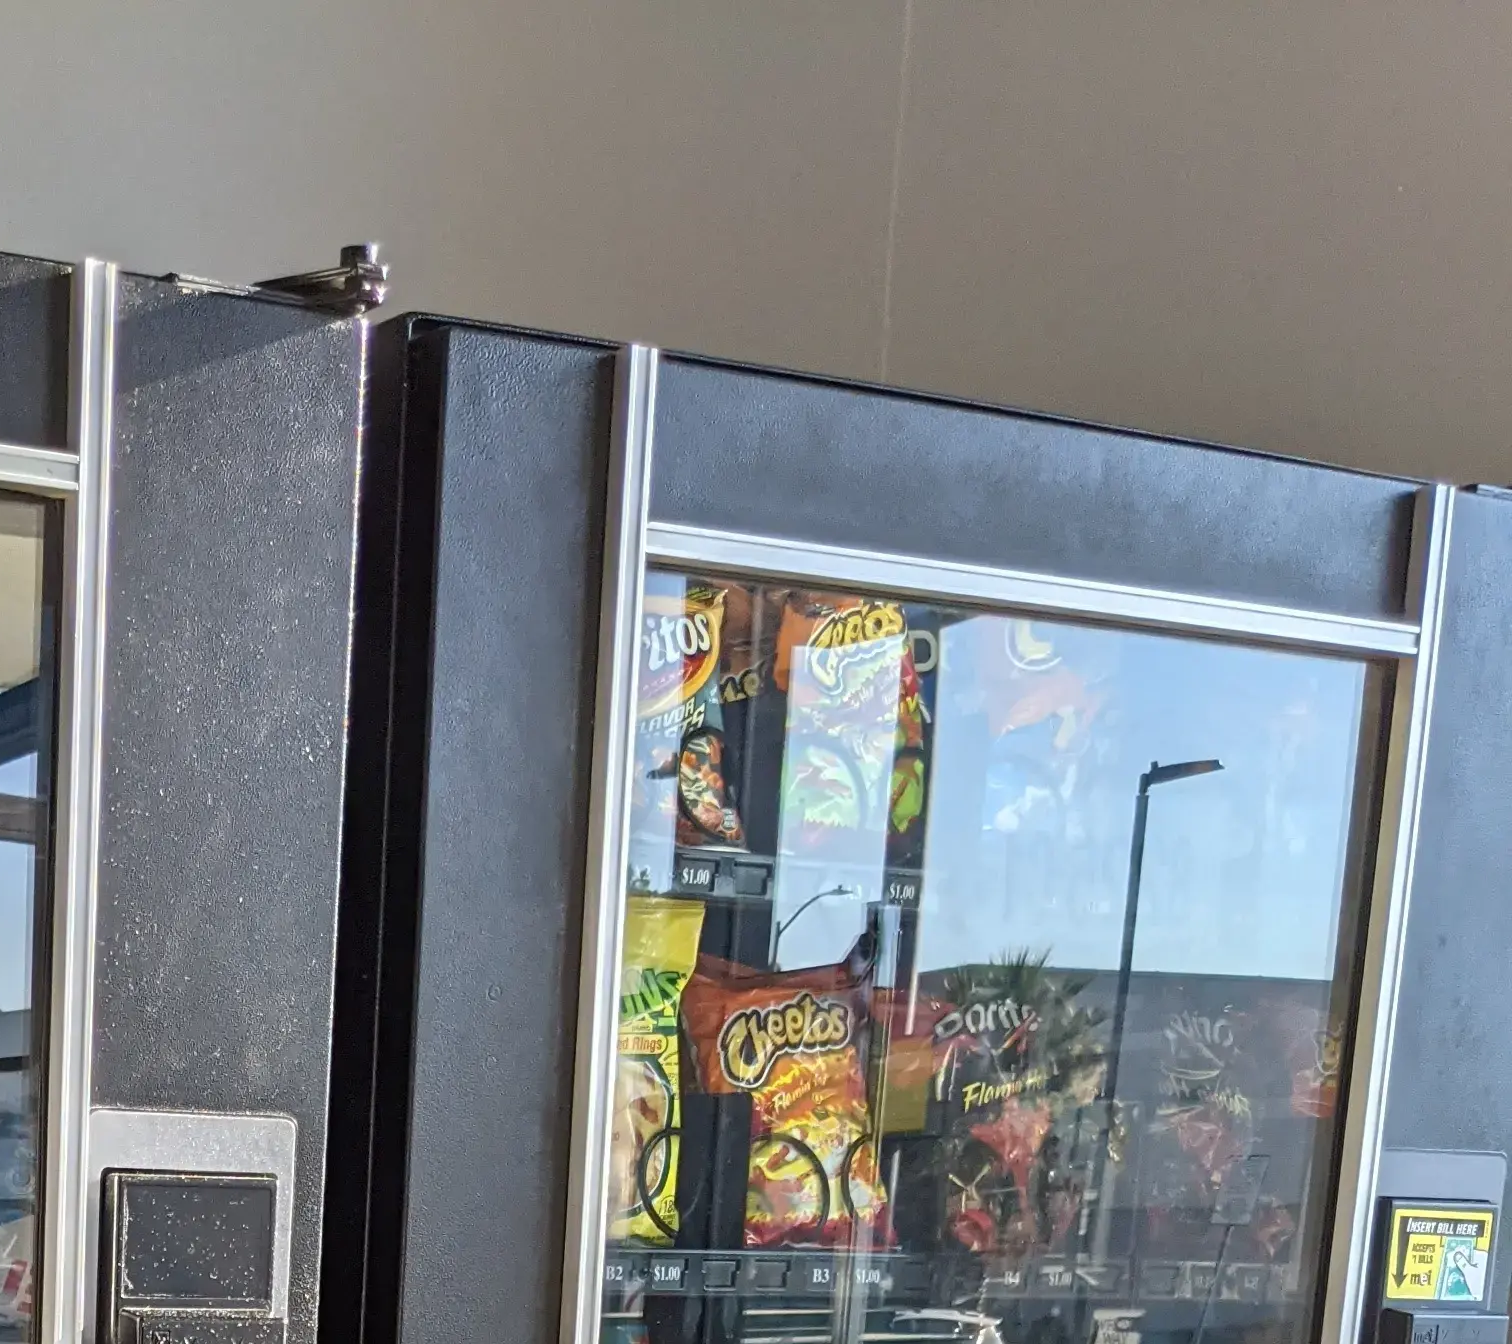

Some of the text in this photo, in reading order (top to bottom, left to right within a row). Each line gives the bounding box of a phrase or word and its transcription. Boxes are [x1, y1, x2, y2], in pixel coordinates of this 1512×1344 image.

[681, 867, 710, 884] $1.00
[889, 884, 915, 900] $1.00
[723, 995, 848, 1083] Cheetos
[1407, 1218, 1478, 1236] INSERT BILL HERE
[605, 1265, 623, 1281] B2
[654, 1265, 680, 1282] $1.00
[812, 1268, 830, 1284] B3
